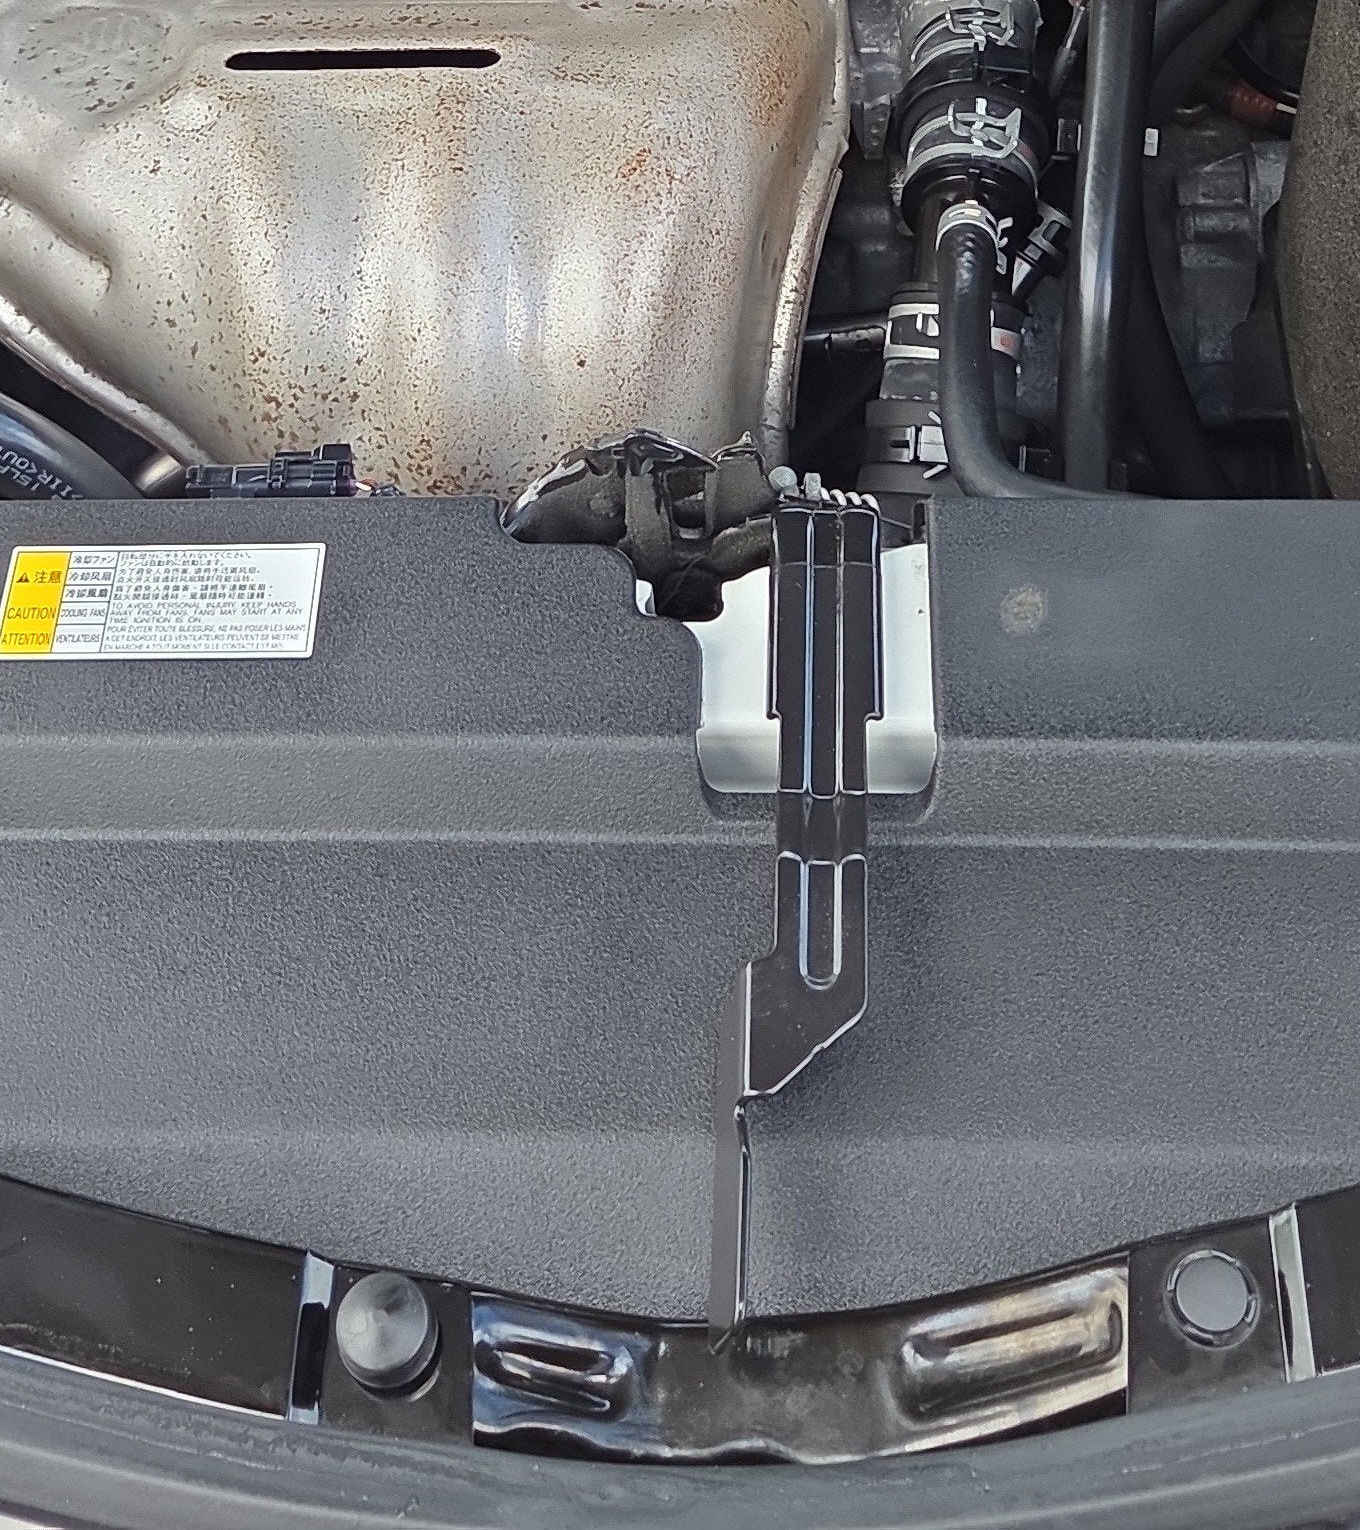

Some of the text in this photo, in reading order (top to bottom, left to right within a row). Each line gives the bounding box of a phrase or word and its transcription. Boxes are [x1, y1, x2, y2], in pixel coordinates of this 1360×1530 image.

[33, 571, 62, 583] 注意
[7, 607, 57, 619] CAUTION
[60, 609, 106, 617] COOLING FANS
[1, 633, 52, 645] ATTENTION
[56, 634, 100, 643] VENTILATEURS
